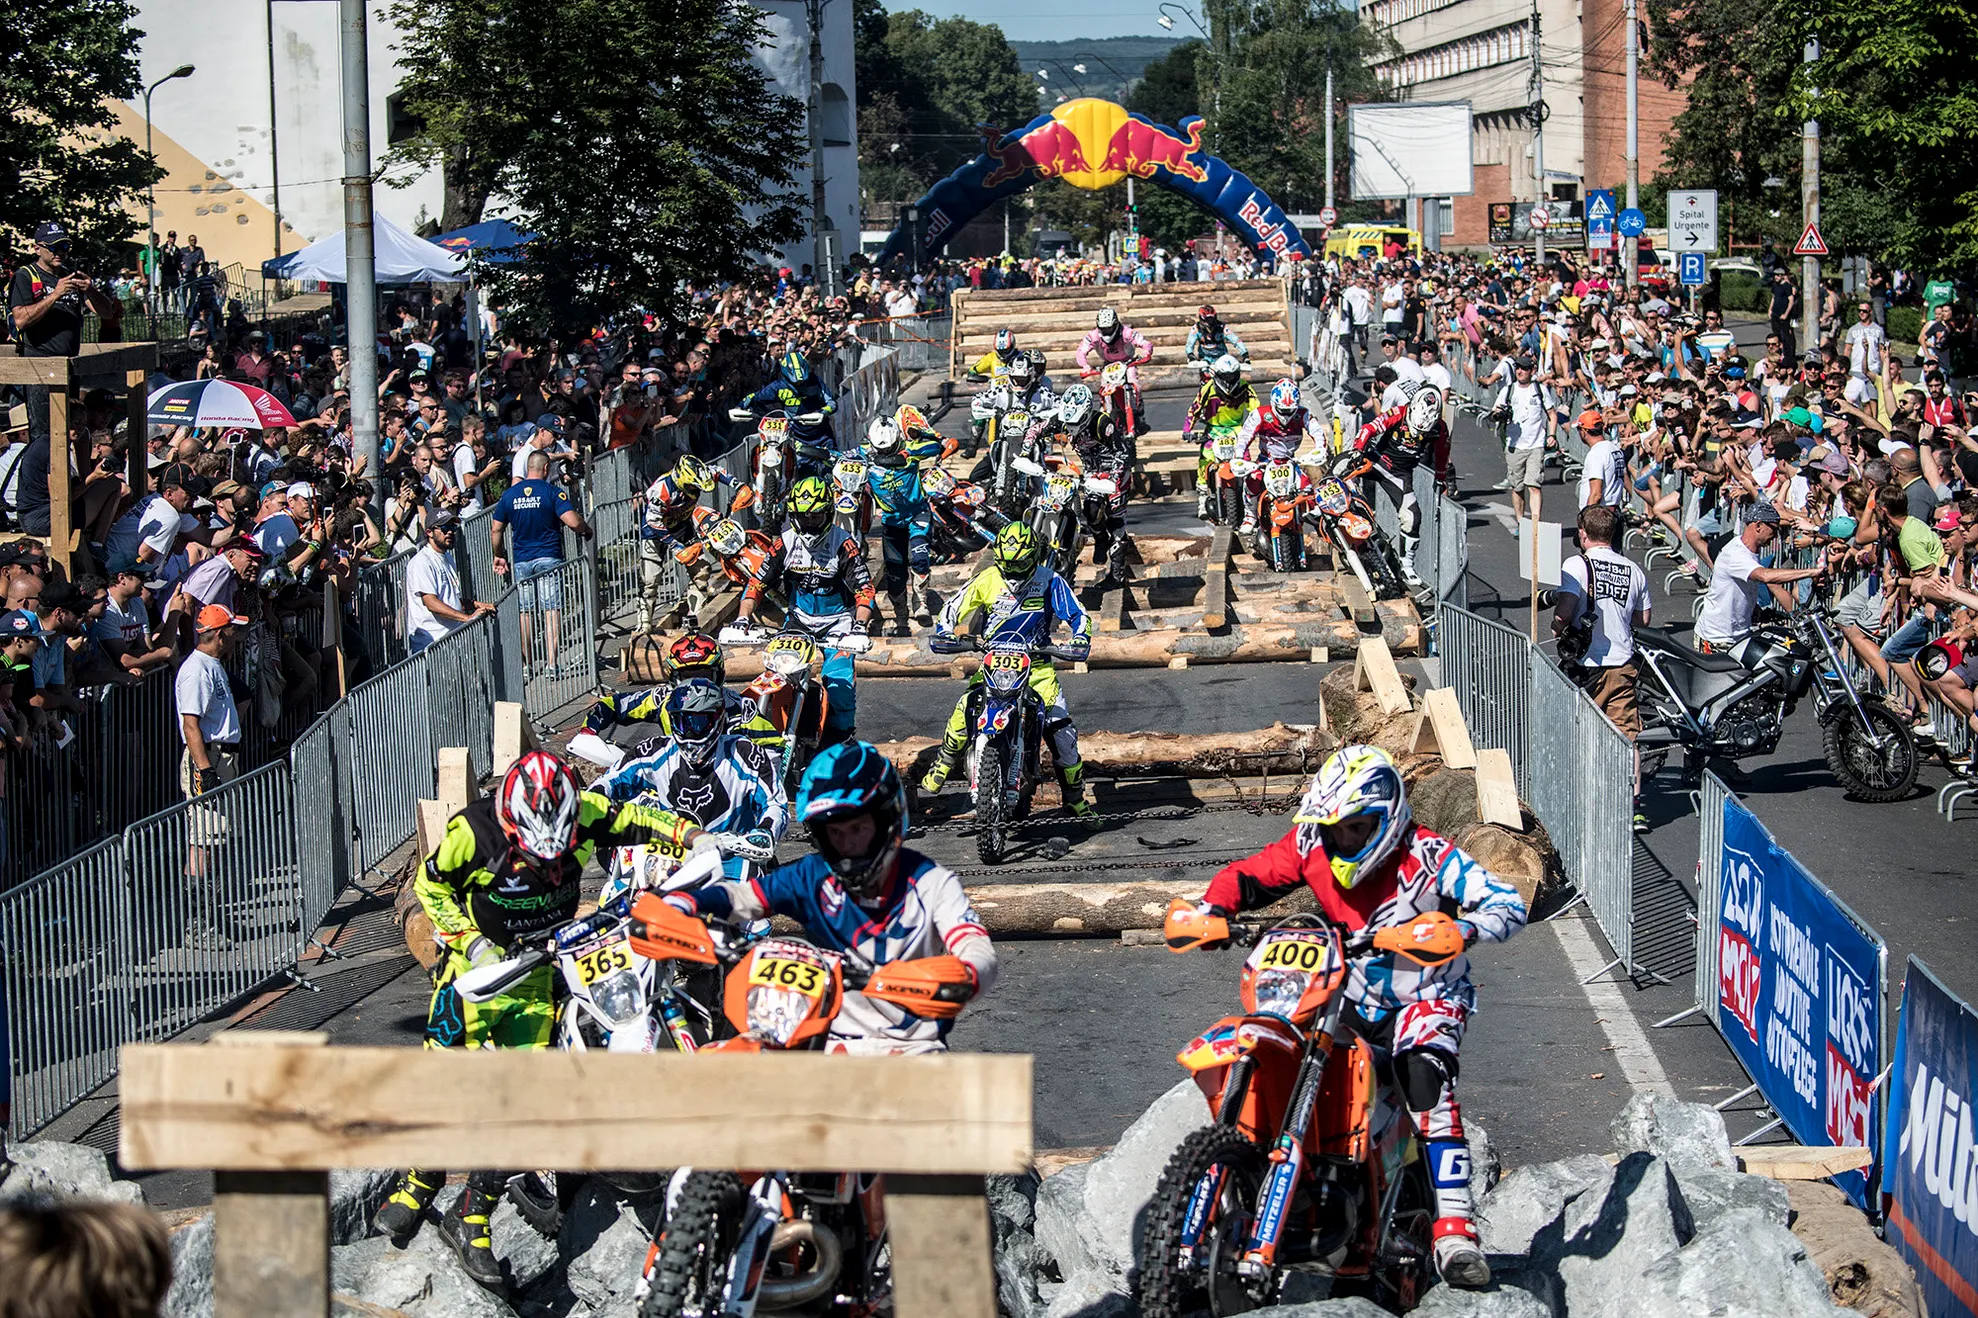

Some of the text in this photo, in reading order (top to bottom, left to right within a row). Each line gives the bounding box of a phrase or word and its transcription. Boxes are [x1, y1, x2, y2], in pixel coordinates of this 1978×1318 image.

[1238, 199, 1279, 240] Red
[1679, 210, 1705, 220] Spital
[1686, 257, 1700, 276] P
[766, 421, 782, 430] 331
[841, 463, 861, 474] 433
[1271, 468, 1290, 479] 300
[1051, 478, 1071, 489] 477
[513, 496, 541, 504] ASSAULT
[513, 502, 541, 510] SECURITY
[1611, 565, 1630, 576] Bull
[776, 640, 803, 651] 310
[993, 656, 1021, 669] 303
[646, 842, 685, 859] 360
[1263, 942, 1319, 969] 400
[581, 948, 627, 982] 365
[758, 960, 820, 992] 463
[1262, 1176, 1289, 1241] METZELER
